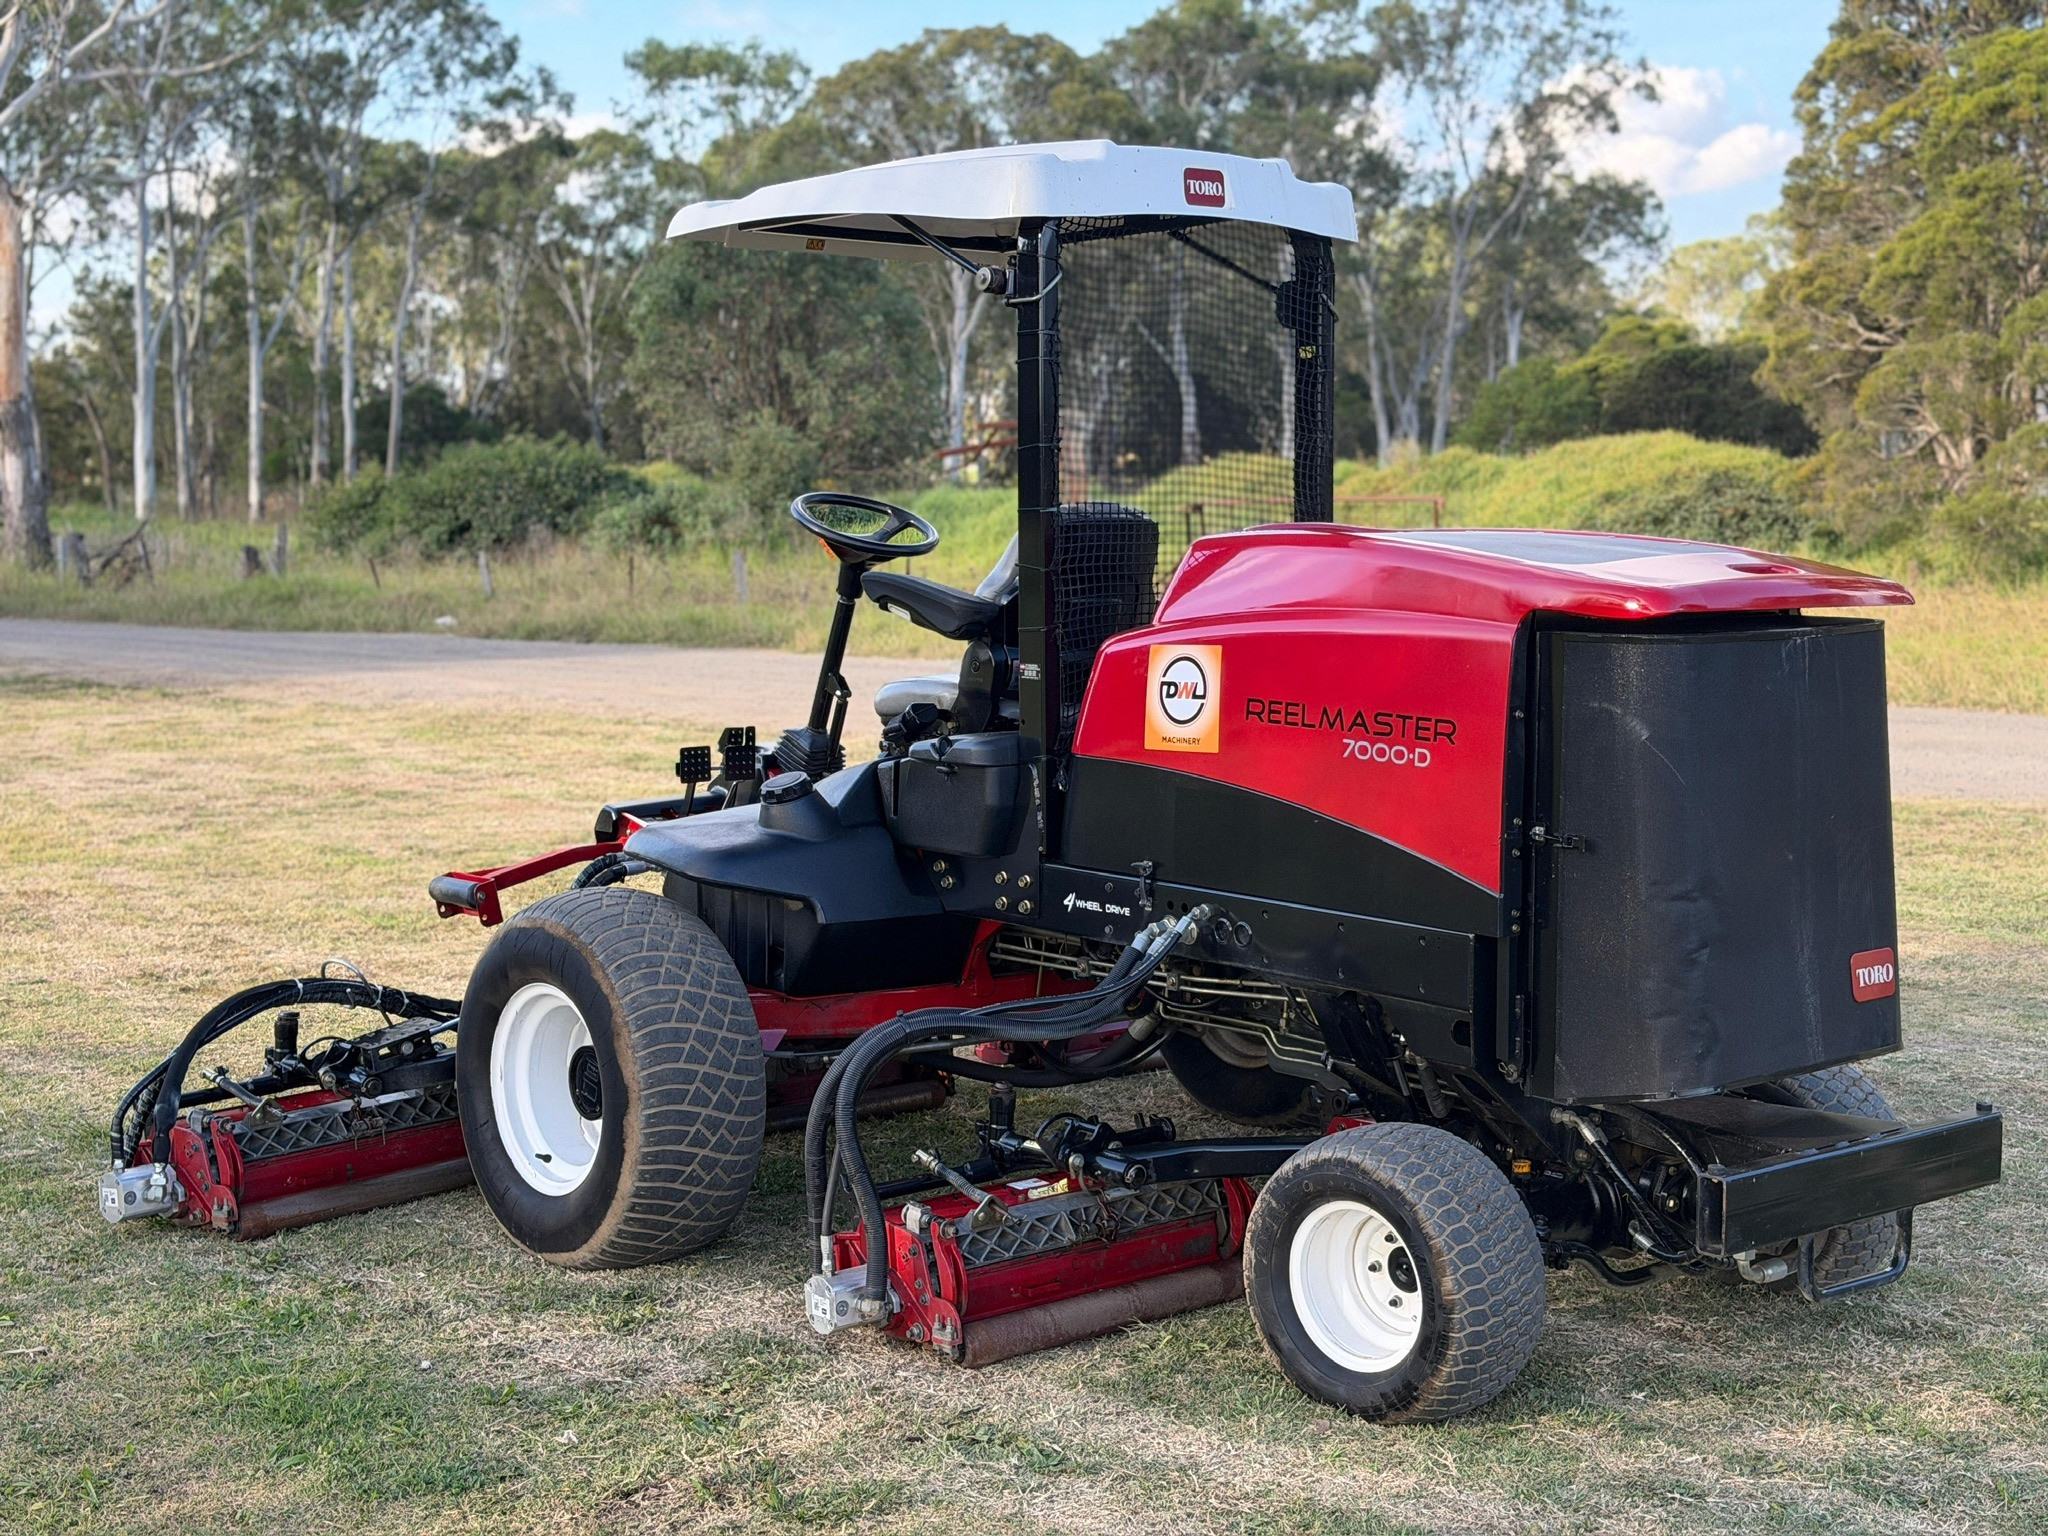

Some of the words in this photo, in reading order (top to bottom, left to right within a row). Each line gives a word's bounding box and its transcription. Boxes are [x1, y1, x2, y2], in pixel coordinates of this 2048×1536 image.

[1186, 179, 1223, 197] TORO
[1160, 680, 1207, 701] DWL
[1245, 697, 1458, 746] REELMASTER
[1161, 735, 1202, 746] MACHINERY
[1075, 899, 1103, 912] WHEEL
[1105, 903, 1131, 917] DRIVE
[1855, 962, 1894, 988] TORO
